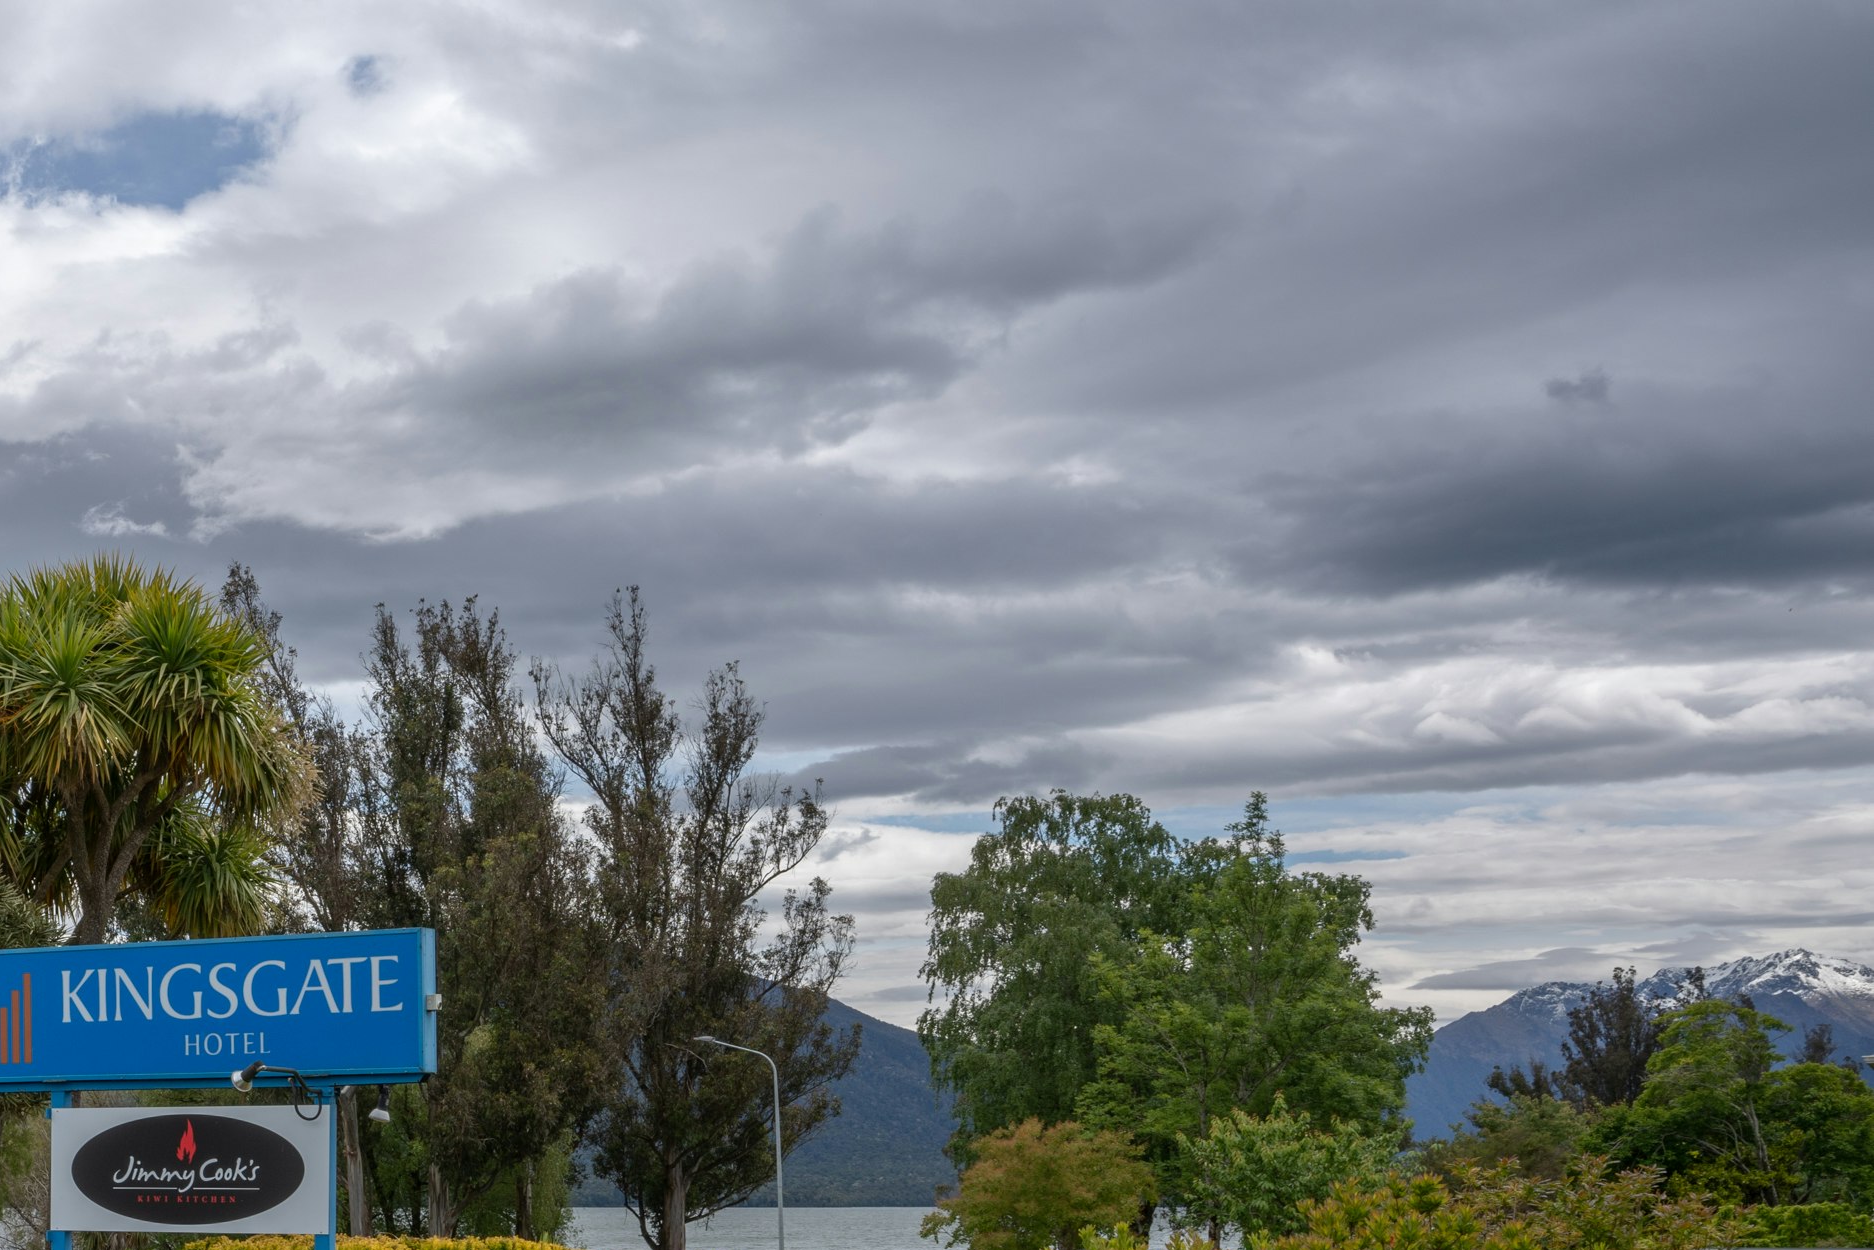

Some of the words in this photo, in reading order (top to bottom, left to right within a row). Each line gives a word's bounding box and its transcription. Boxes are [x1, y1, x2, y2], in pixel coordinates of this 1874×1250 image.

[61, 955, 404, 1023] KINGSGATE
[184, 1031, 271, 1056] HOTEL
[112, 1155, 195, 1193] Jimmy
[199, 1157, 260, 1182] Cook's
[136, 1194, 169, 1203] KIWI
[177, 1194, 236, 1203] KITCHEN
